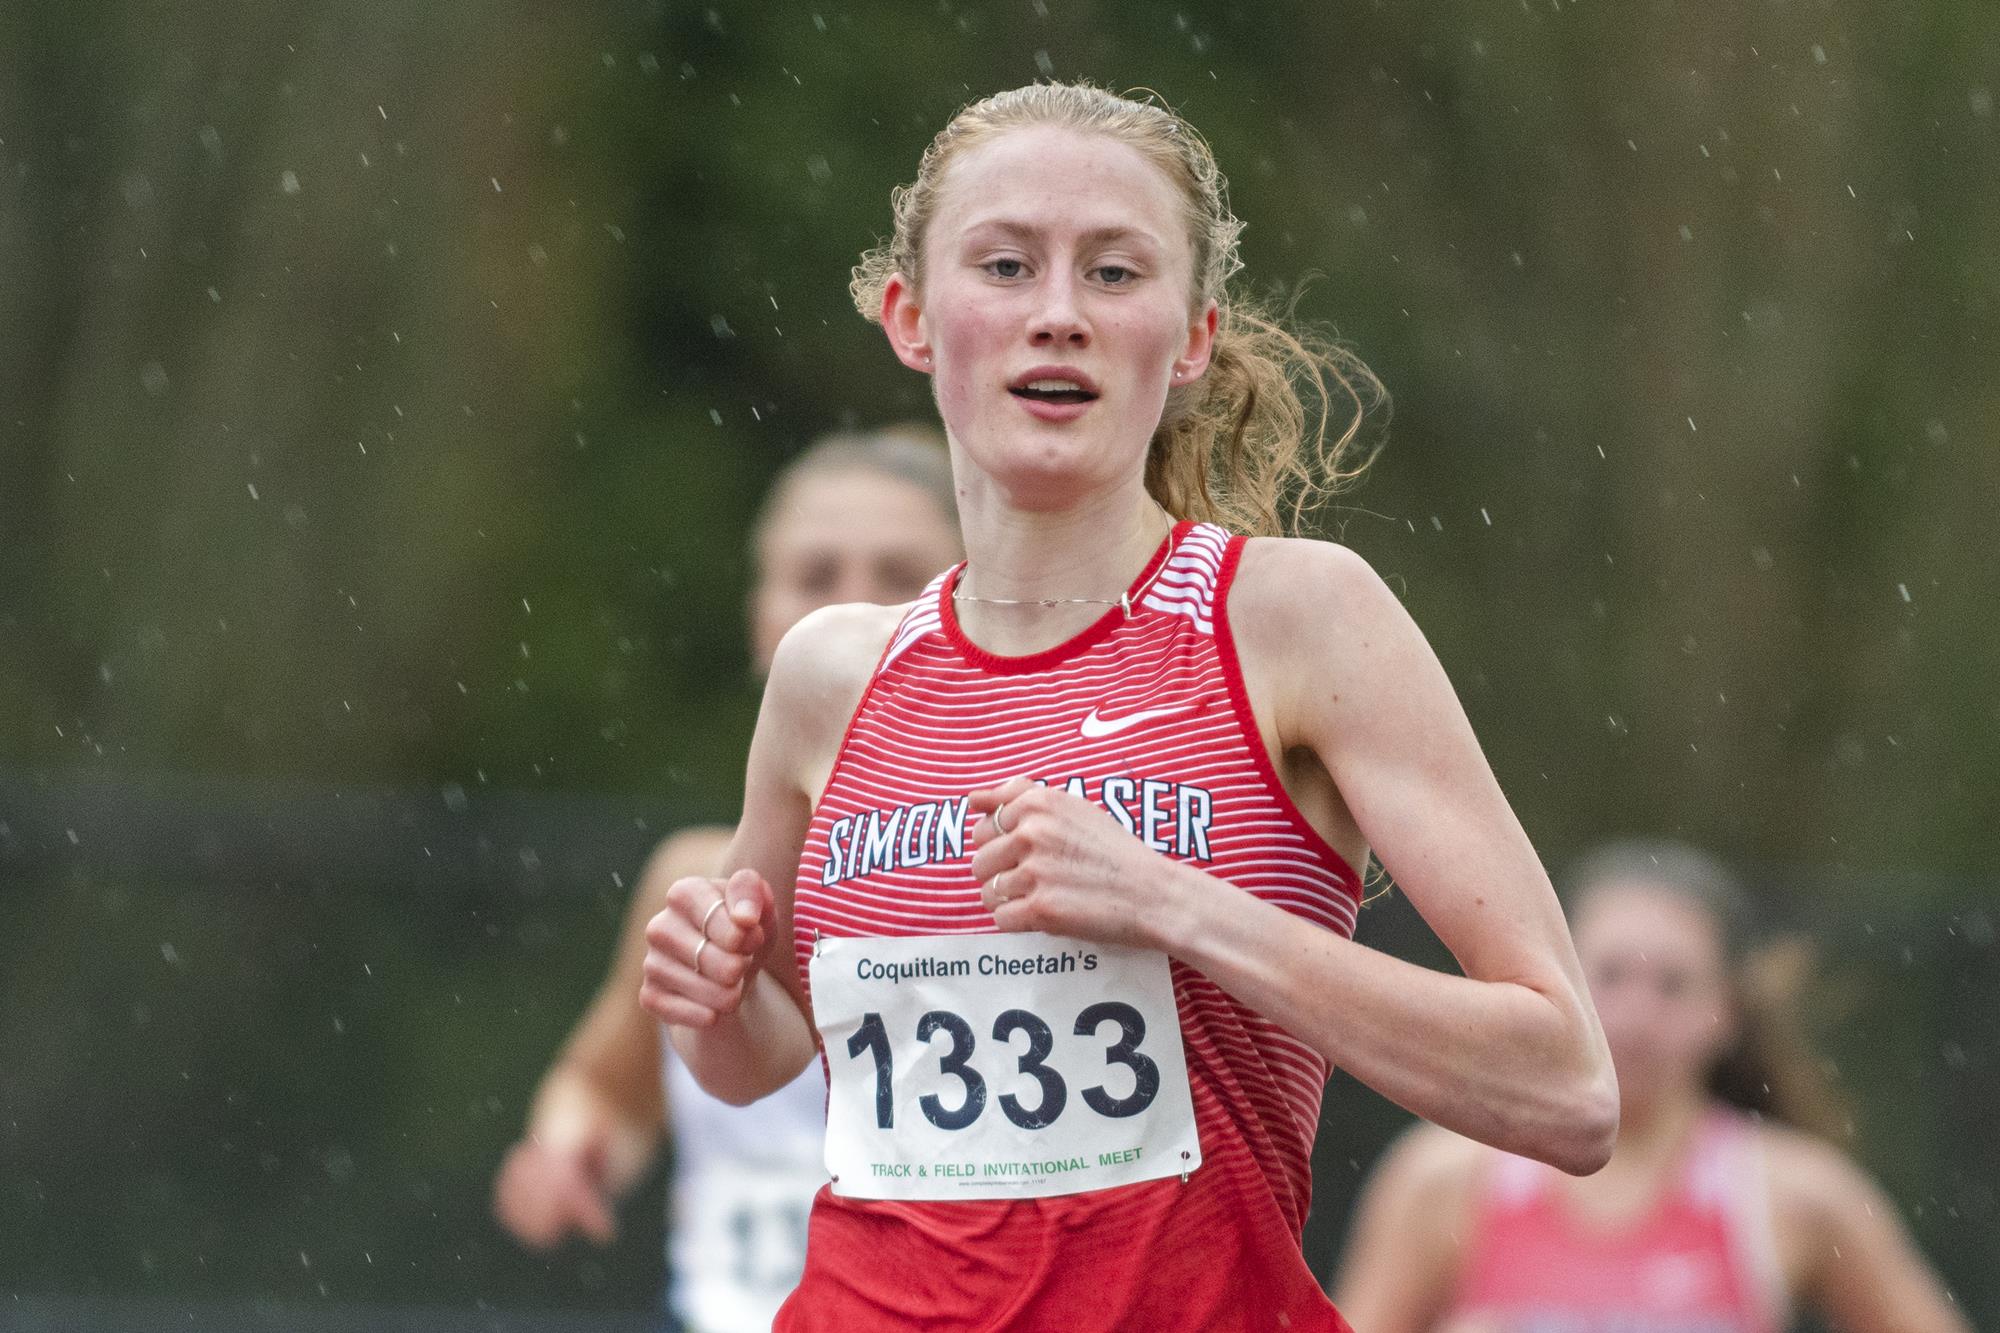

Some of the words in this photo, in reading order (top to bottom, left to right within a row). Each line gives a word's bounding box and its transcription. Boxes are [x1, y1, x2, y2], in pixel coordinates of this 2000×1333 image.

[821, 795, 969, 887] SIMON
[857, 956, 970, 984] Coquitlam
[978, 951, 1098, 977] Cheetah's
[846, 1001, 1160, 1130] 1333
[871, 1163, 911, 1177] TRACK
[918, 1164, 928, 1177] &
[934, 1163, 975, 1177] FIELD
[983, 1156, 1090, 1177] INVITATIONAL
[1099, 1147, 1143, 1166] MEET
